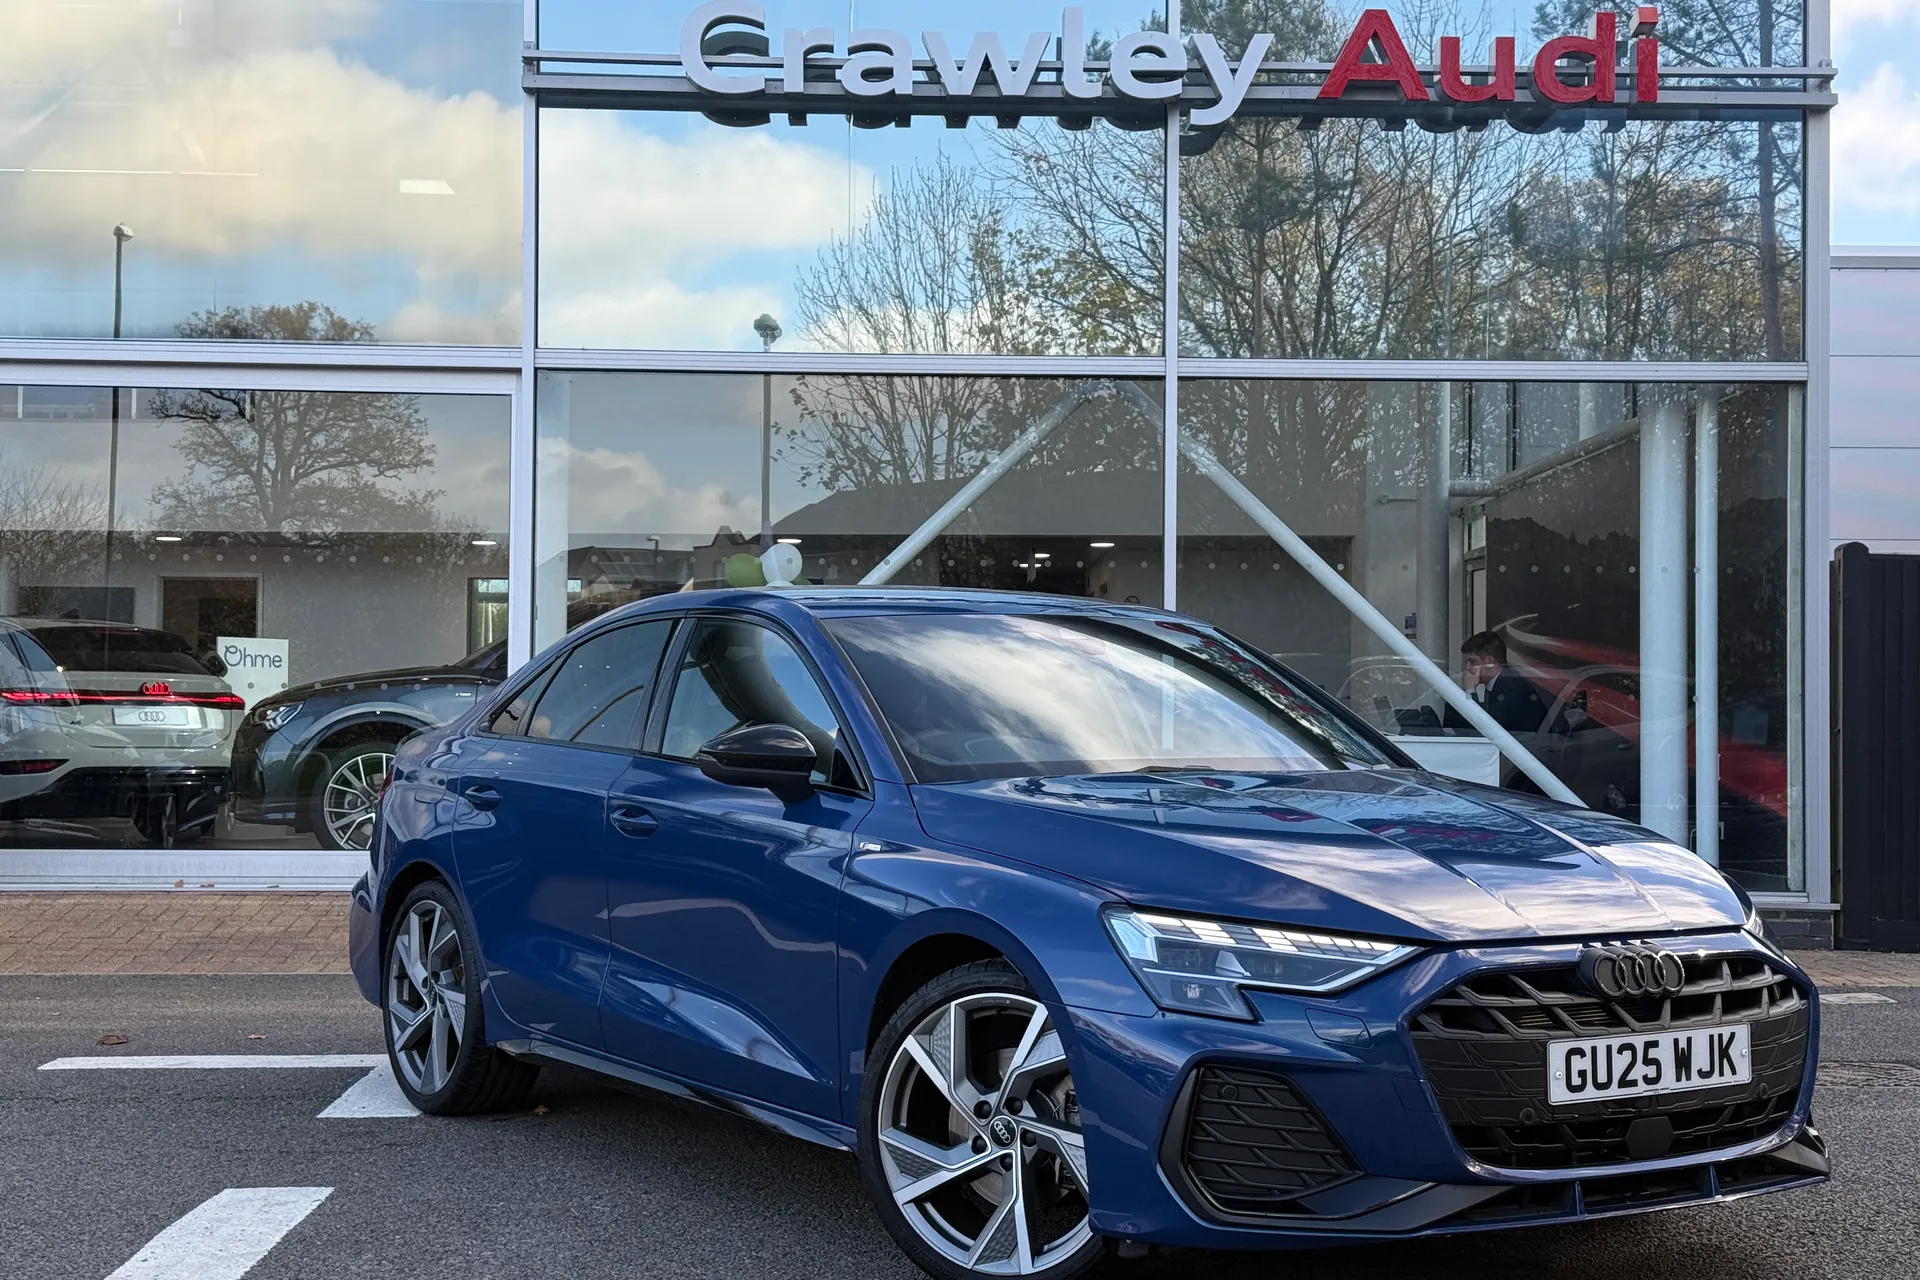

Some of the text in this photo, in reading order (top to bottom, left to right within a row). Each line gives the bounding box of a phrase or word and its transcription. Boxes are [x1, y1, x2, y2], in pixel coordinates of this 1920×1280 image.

[679, 0, 1659, 126] Crawley Audi
[224, 645, 283, 668] Ohme
[1564, 1031, 1738, 1094] GU25 WJK
